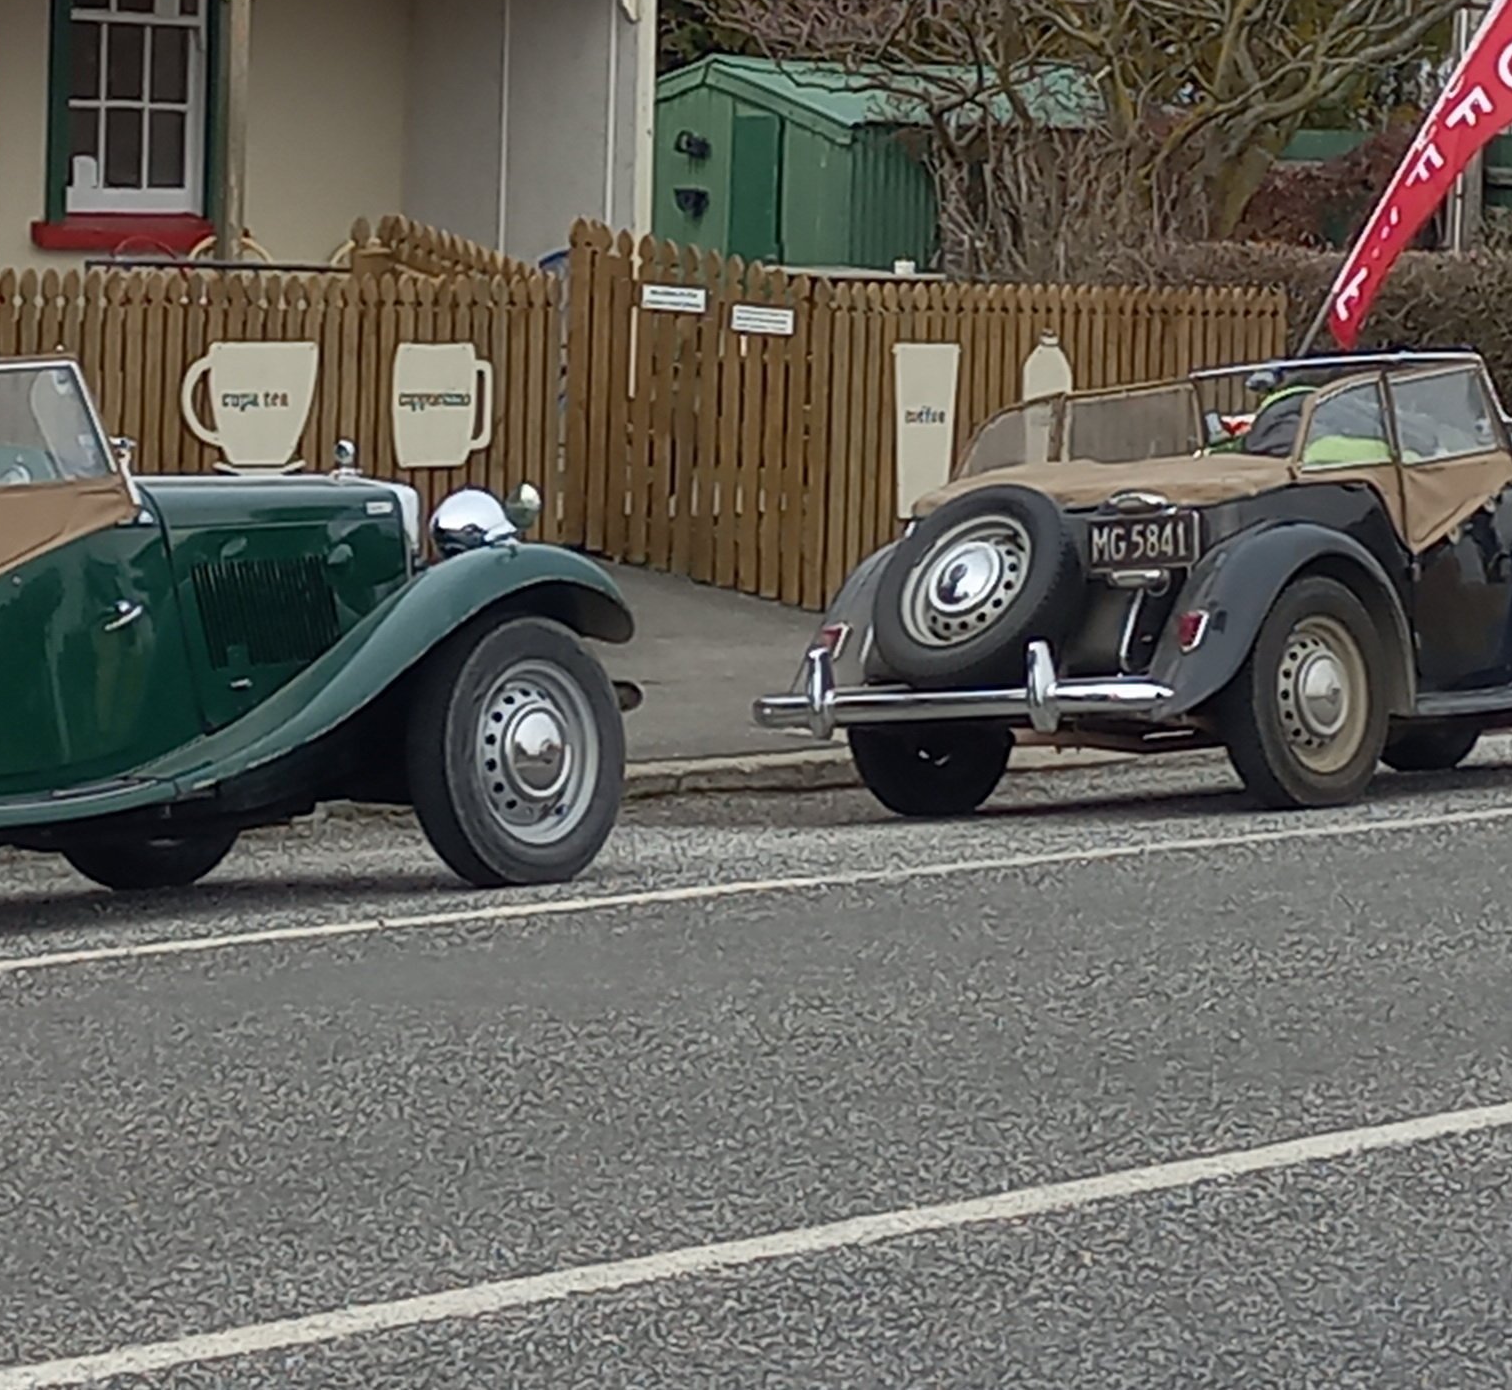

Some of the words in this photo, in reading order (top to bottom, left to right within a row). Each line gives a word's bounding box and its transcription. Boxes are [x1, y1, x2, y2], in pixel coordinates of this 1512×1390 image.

[263, 391, 289, 408] tea
[1092, 525, 1127, 563] MG
[1131, 521, 1187, 559] 5841
